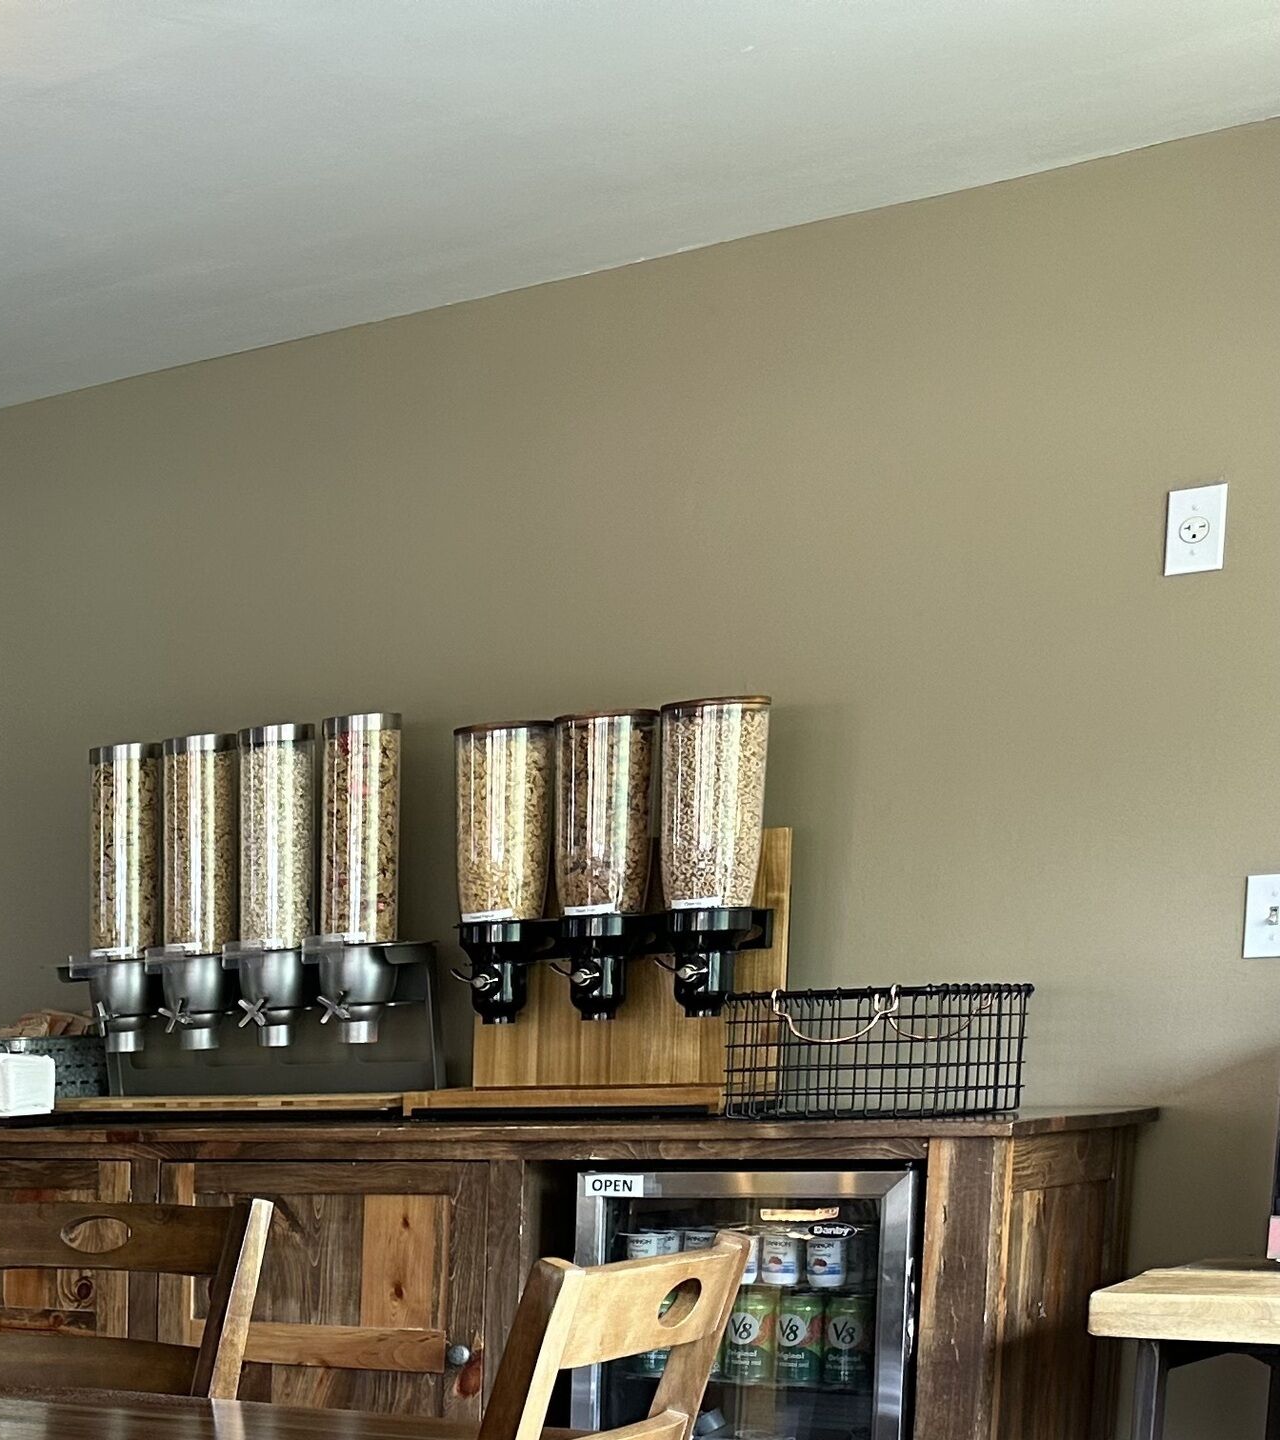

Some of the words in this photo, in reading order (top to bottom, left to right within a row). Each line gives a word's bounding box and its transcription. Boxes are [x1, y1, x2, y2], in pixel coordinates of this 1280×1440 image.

[591, 1178, 633, 1192] OPEN
[813, 1225, 853, 1236] Danby
[731, 1315, 753, 1340] V8
[779, 1317, 799, 1342] V8
[832, 1320, 856, 1345] V8
